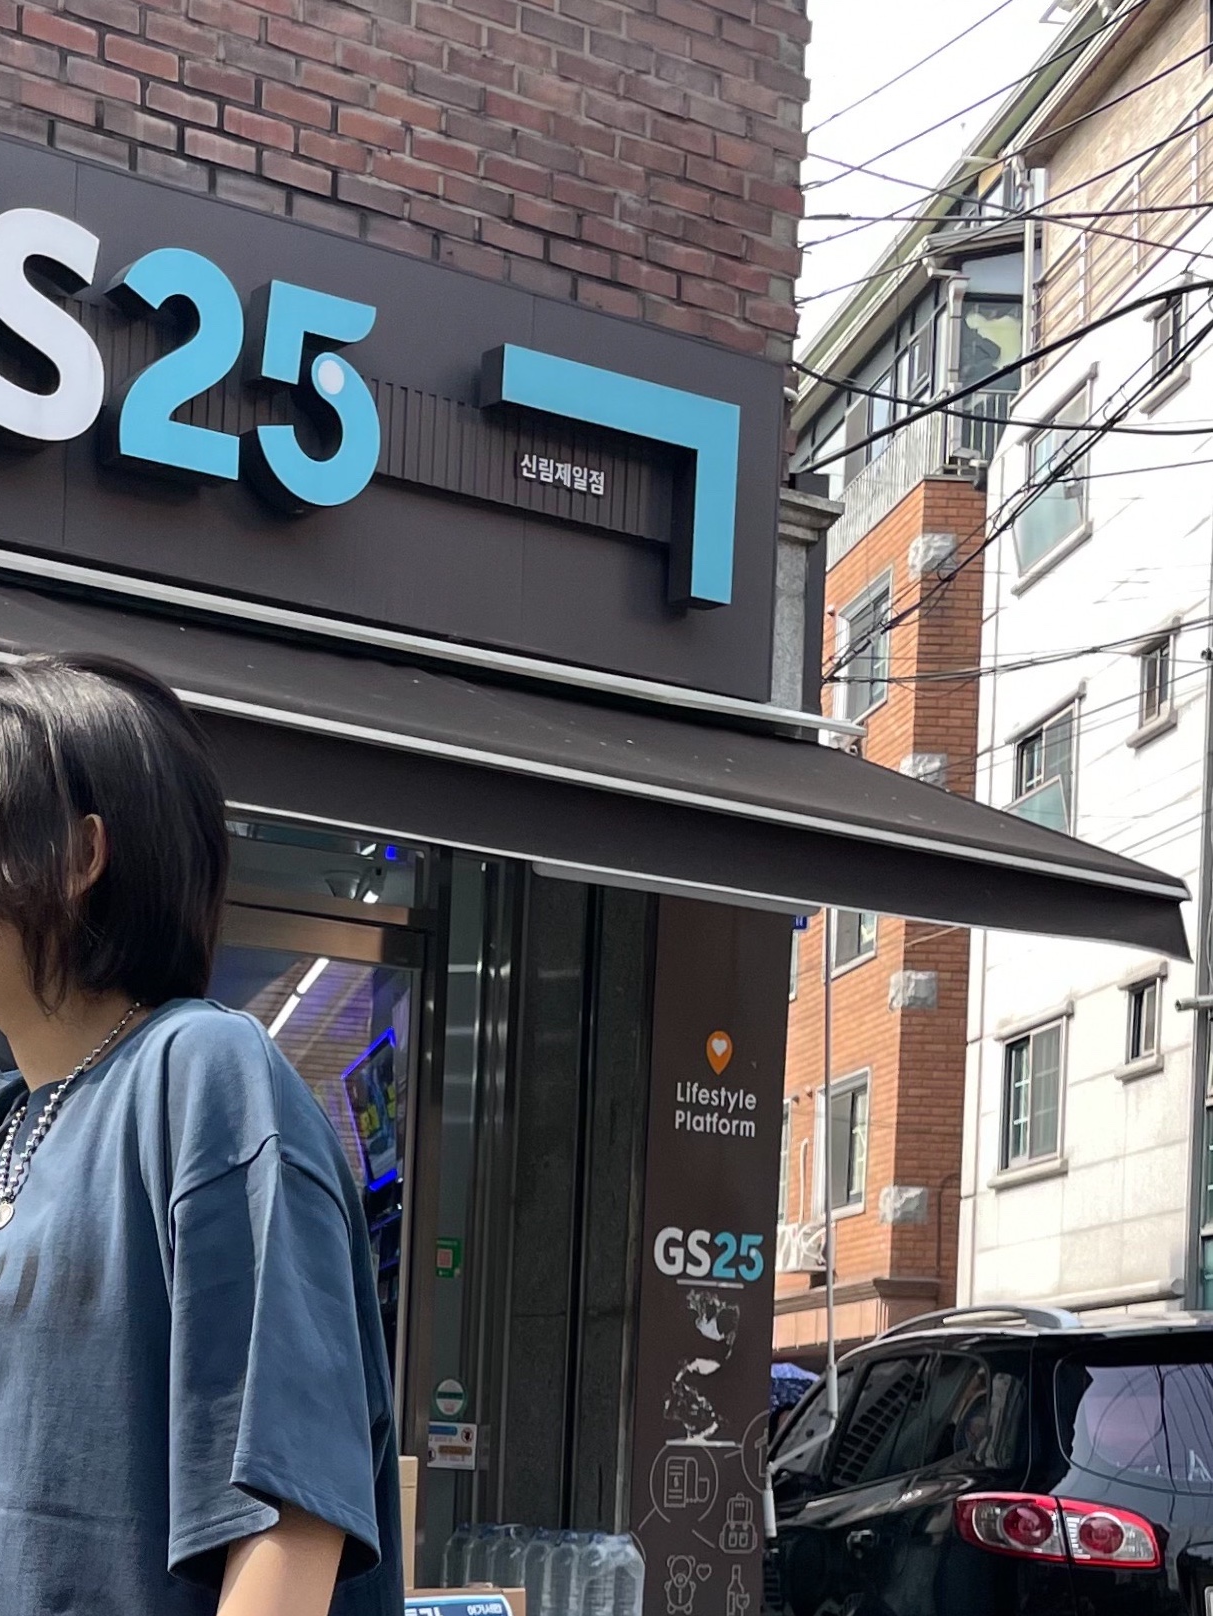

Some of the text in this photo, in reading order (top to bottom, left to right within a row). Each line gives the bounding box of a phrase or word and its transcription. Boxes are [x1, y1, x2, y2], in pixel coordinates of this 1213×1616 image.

[520, 453, 605, 496] 신림제일점
[676, 1081, 757, 1114] Lifestyle
[674, 1110, 756, 1138] Platform
[654, 1226, 764, 1282] GS25
